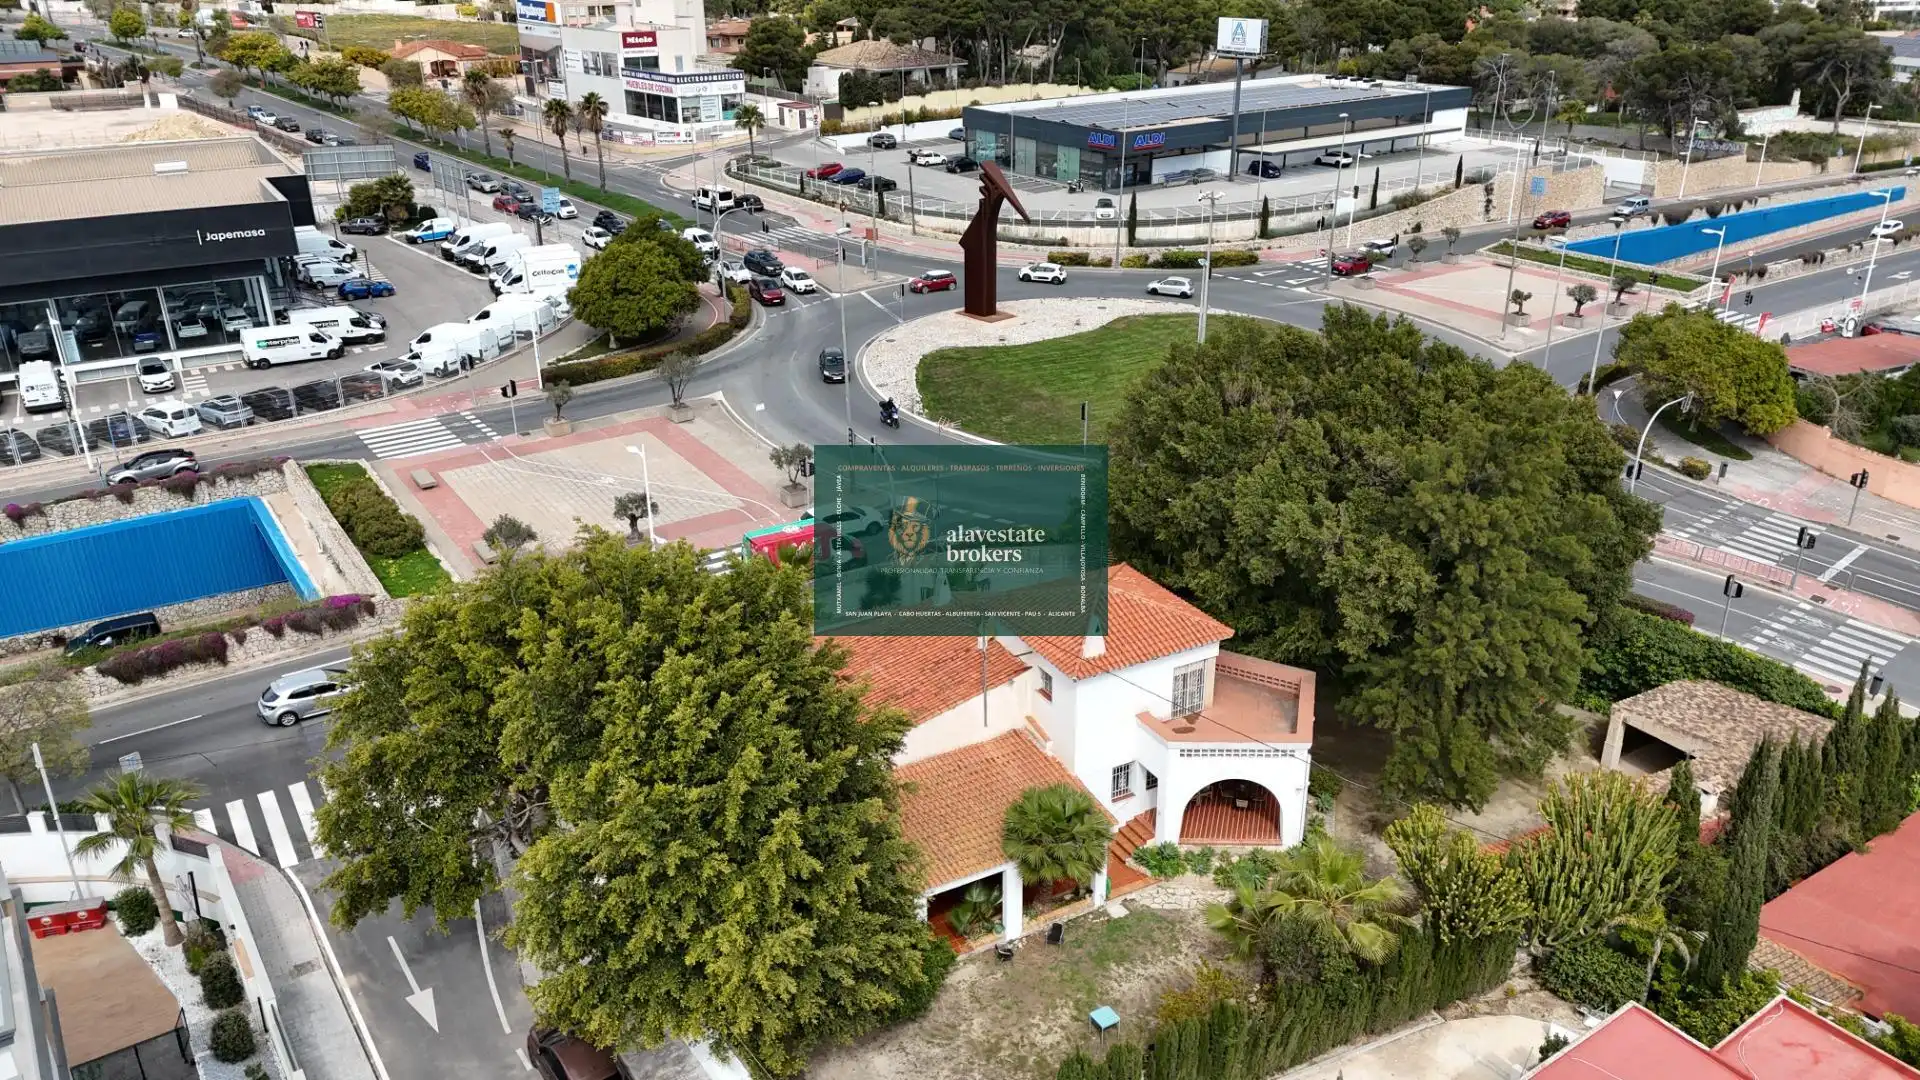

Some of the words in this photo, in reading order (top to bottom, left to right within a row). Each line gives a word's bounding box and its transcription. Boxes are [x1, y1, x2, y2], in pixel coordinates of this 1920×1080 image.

[626, 35, 653, 44] Miele
[655, 82, 673, 93] COCINA
[1088, 132, 1115, 147] ALDI
[1135, 132, 1166, 146] ALDI
[205, 229, 266, 242] Japemasa
